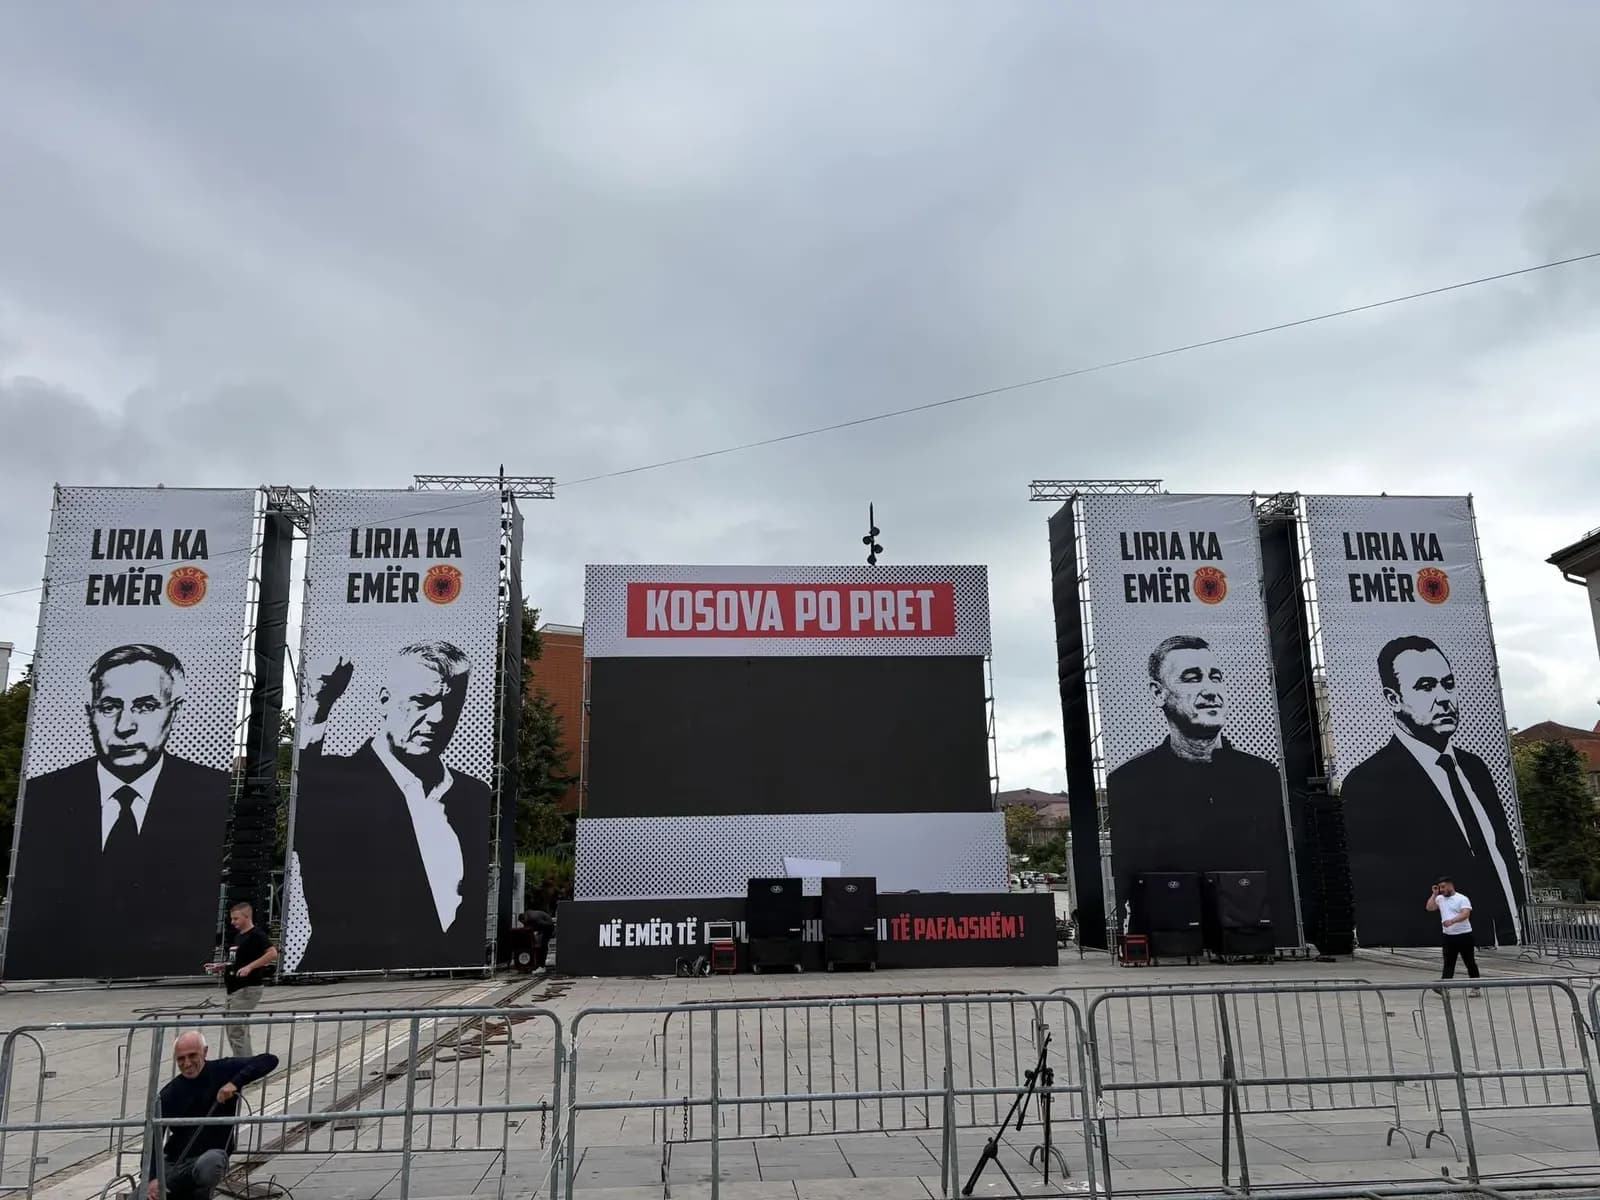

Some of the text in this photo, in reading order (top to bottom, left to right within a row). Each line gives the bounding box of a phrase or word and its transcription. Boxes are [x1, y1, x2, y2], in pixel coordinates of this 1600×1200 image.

[91, 529, 209, 560] LIRIA KA
[350, 528, 462, 559] LIRIA KA
[1120, 531, 1223, 560] LIRIA KA
[1343, 532, 1444, 562] LIRIA KA
[85, 566, 163, 606] EMËR
[347, 565, 420, 603] EMËR
[1123, 566, 1192, 603] EMËR
[1348, 566, 1416, 603] EMËR
[646, 590, 935, 632] KOSOVA PO PRET
[599, 918, 622, 947] NË
[625, 918, 673, 946] EMËR
[676, 917, 698, 945] TË
[891, 913, 911, 941] TË
